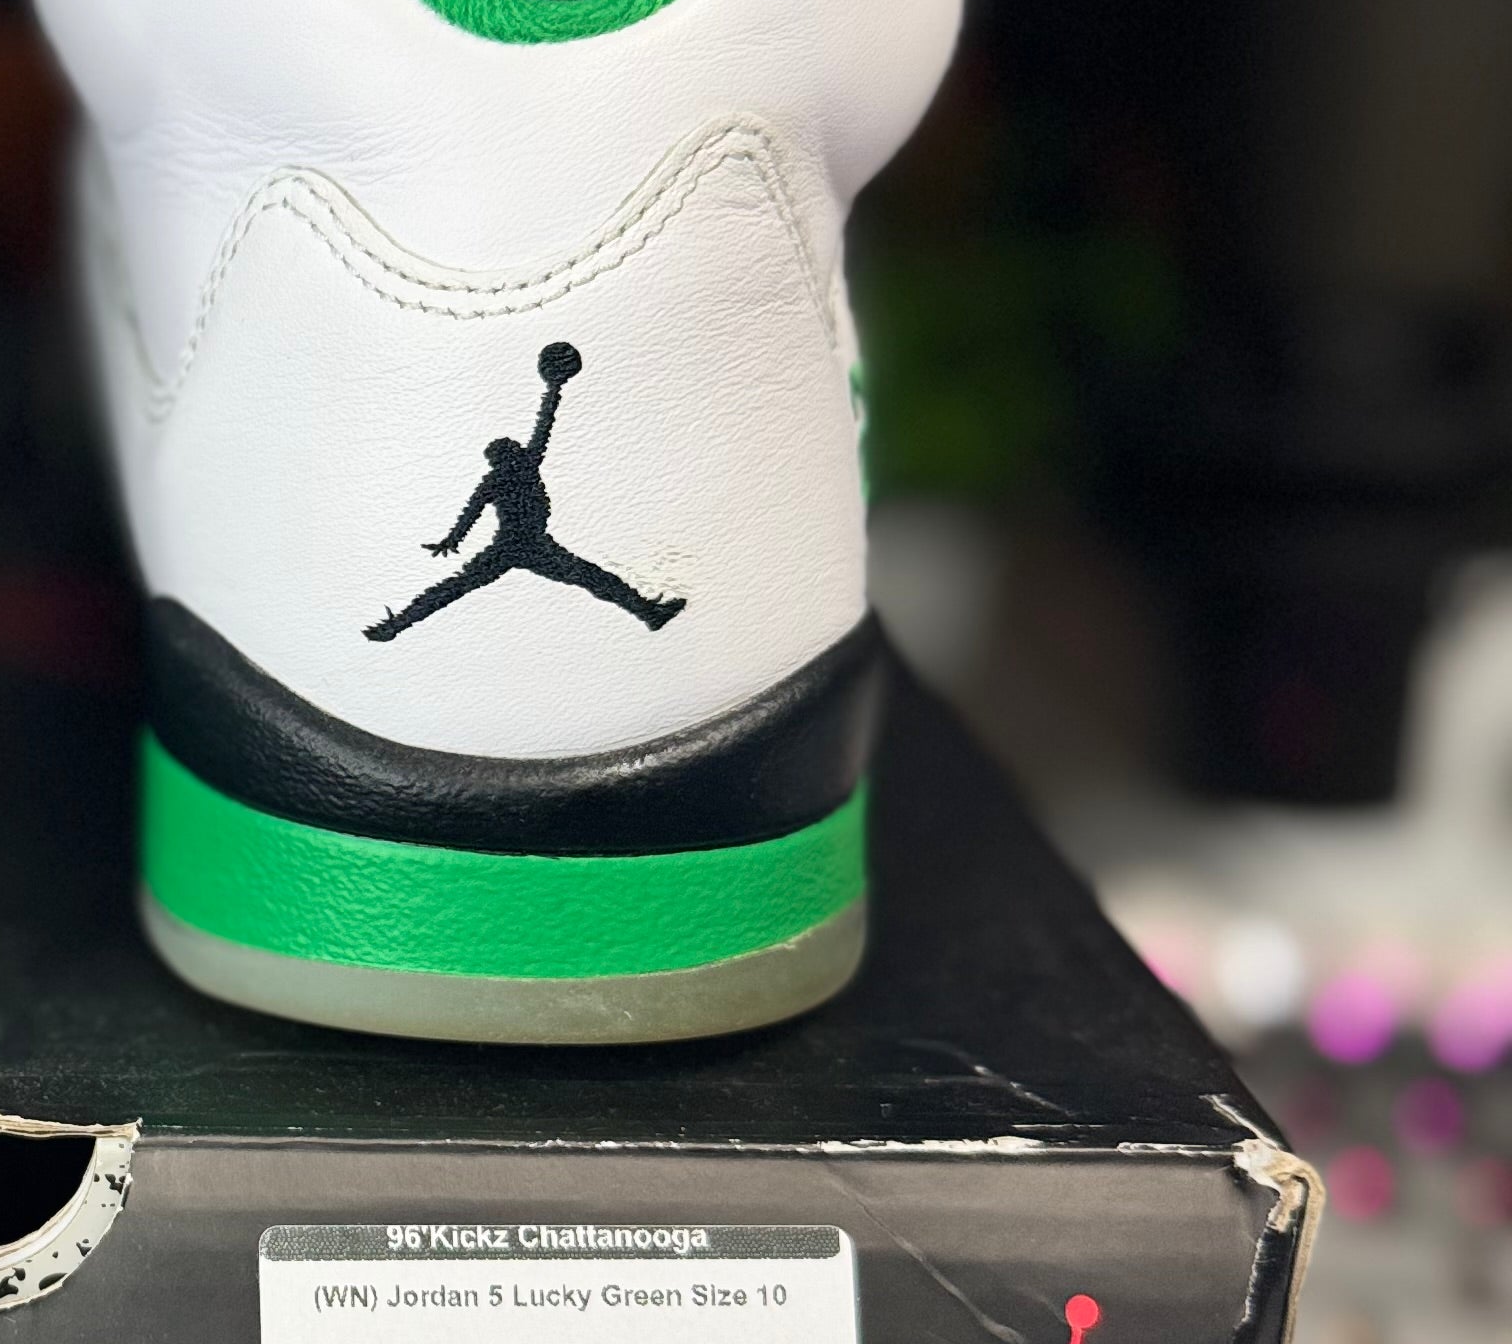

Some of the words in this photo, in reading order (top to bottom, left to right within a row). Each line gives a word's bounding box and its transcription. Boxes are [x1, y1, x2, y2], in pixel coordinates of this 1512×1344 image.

[386, 1225, 509, 1249] 96'Kickz
[518, 1225, 709, 1254] Chattanooga
[313, 1284, 378, 1312] (WN)
[386, 1284, 479, 1307] Jordan
[488, 1284, 504, 1307] 5
[512, 1284, 591, 1312] Lucky
[600, 1284, 683, 1307] Green
[691, 1284, 748, 1307] Size
[756, 1284, 788, 1307] 10
